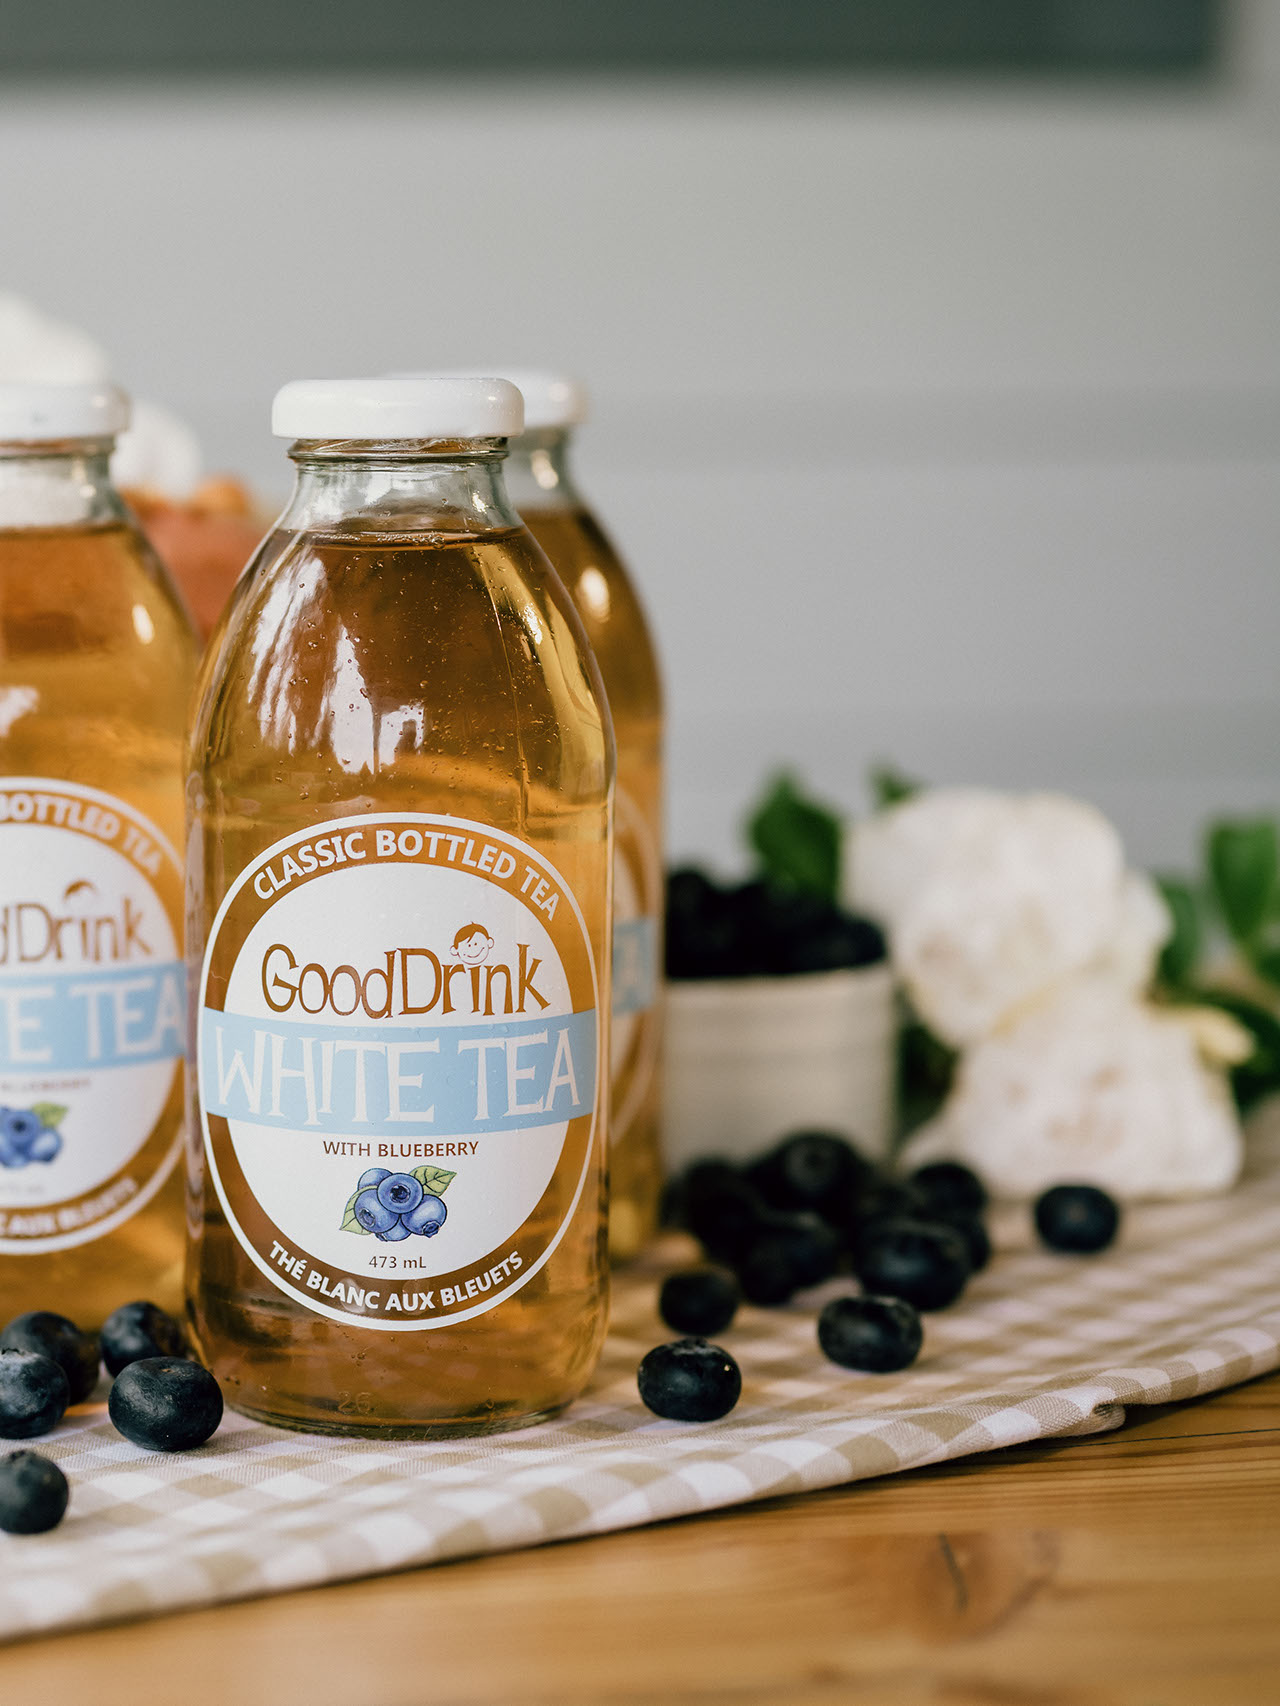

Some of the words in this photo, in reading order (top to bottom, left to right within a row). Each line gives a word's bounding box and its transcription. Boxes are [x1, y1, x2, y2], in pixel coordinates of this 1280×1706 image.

[253, 829, 366, 900] CLASSIC
[376, 829, 517, 880] BOTTLED
[521, 865, 561, 921] TEA
[69, 973, 187, 1060] TEA
[261, 942, 551, 1019] GoodDrink
[215, 1026, 440, 1126] WHITE
[458, 1028, 581, 1120] TEA
[323, 1141, 371, 1157] WITH
[378, 1141, 479, 1157] BLUEBERRY
[269, 1240, 307, 1280] THÉ
[307, 1269, 379, 1310] BLANC
[385, 1291, 435, 1311] AUX
[441, 1251, 523, 1307] BLEUETS
[369, 1256, 397, 1269] 473
[403, 1256, 427, 1269] mL
